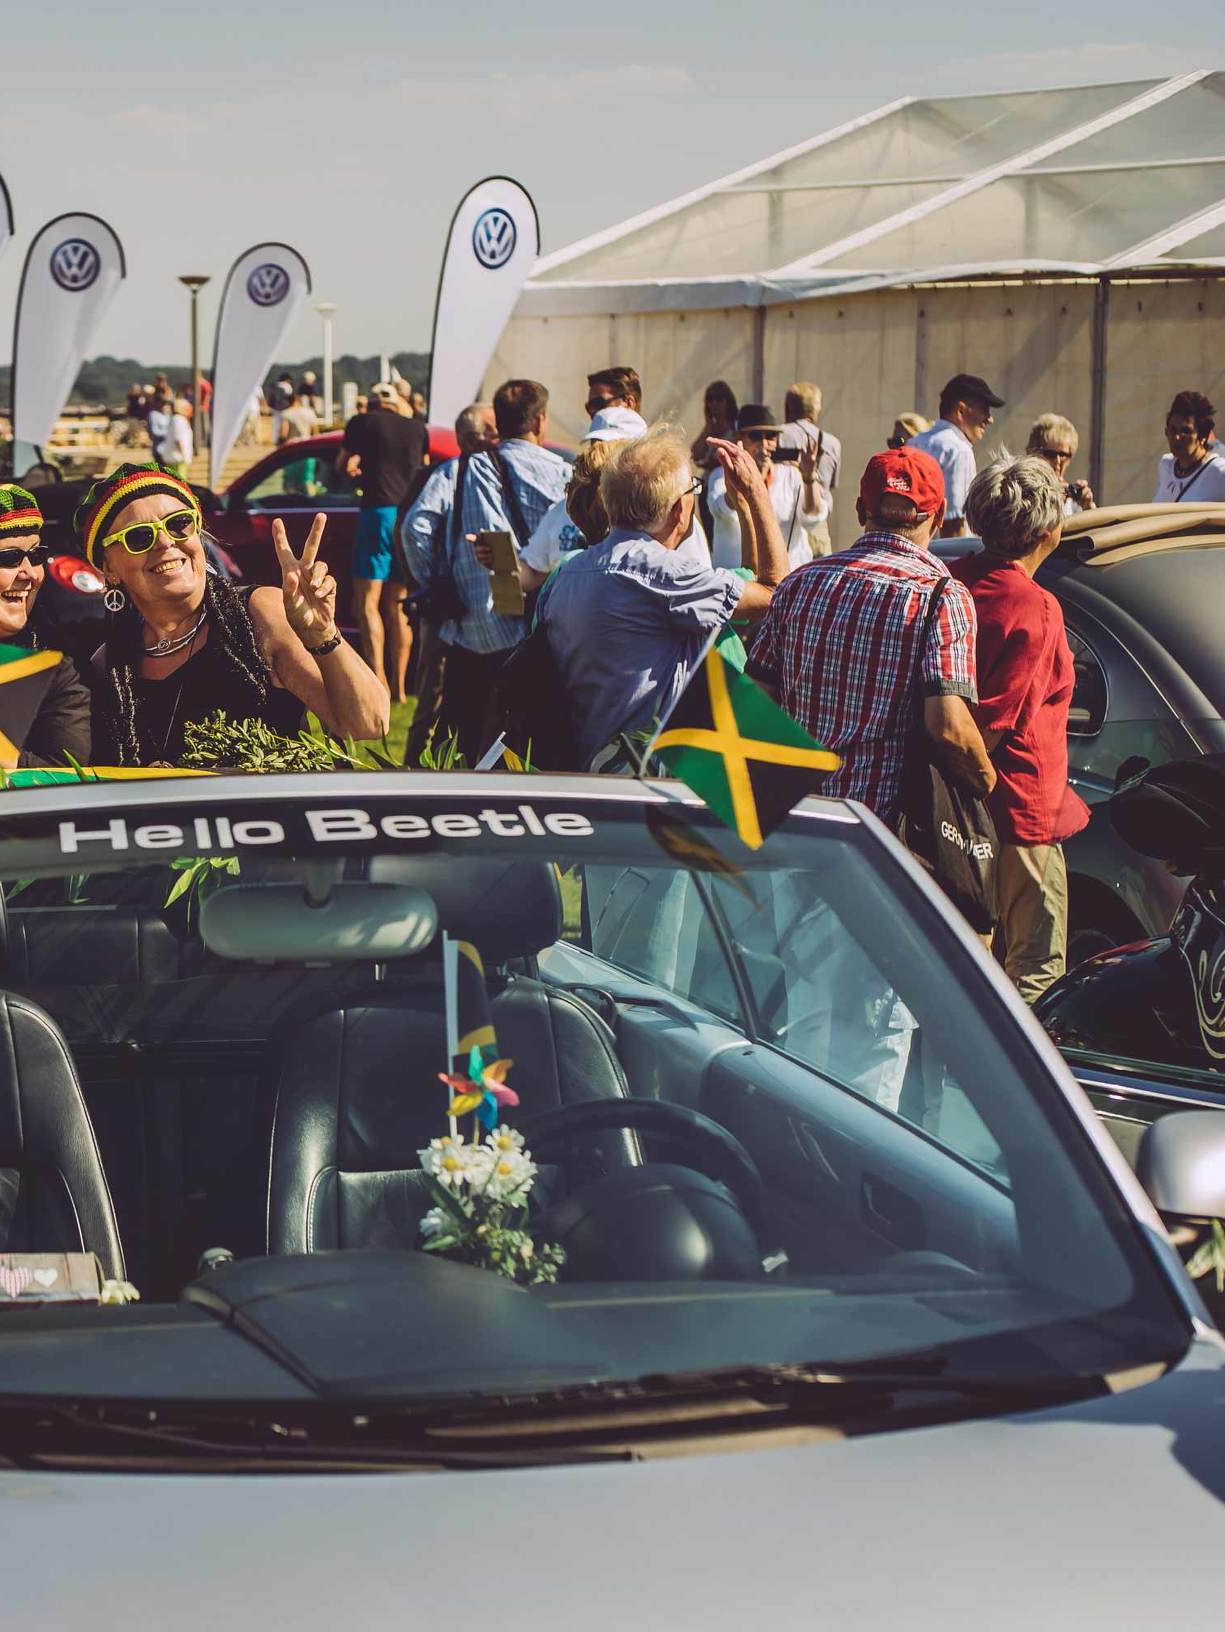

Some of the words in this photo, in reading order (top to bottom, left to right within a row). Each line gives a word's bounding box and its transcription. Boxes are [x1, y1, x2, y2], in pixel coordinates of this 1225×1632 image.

[475, 211, 514, 266] VW
[53, 242, 98, 288] VW
[250, 267, 287, 304] VW
[59, 816, 285, 853] Hello
[305, 805, 594, 842] Beetle
